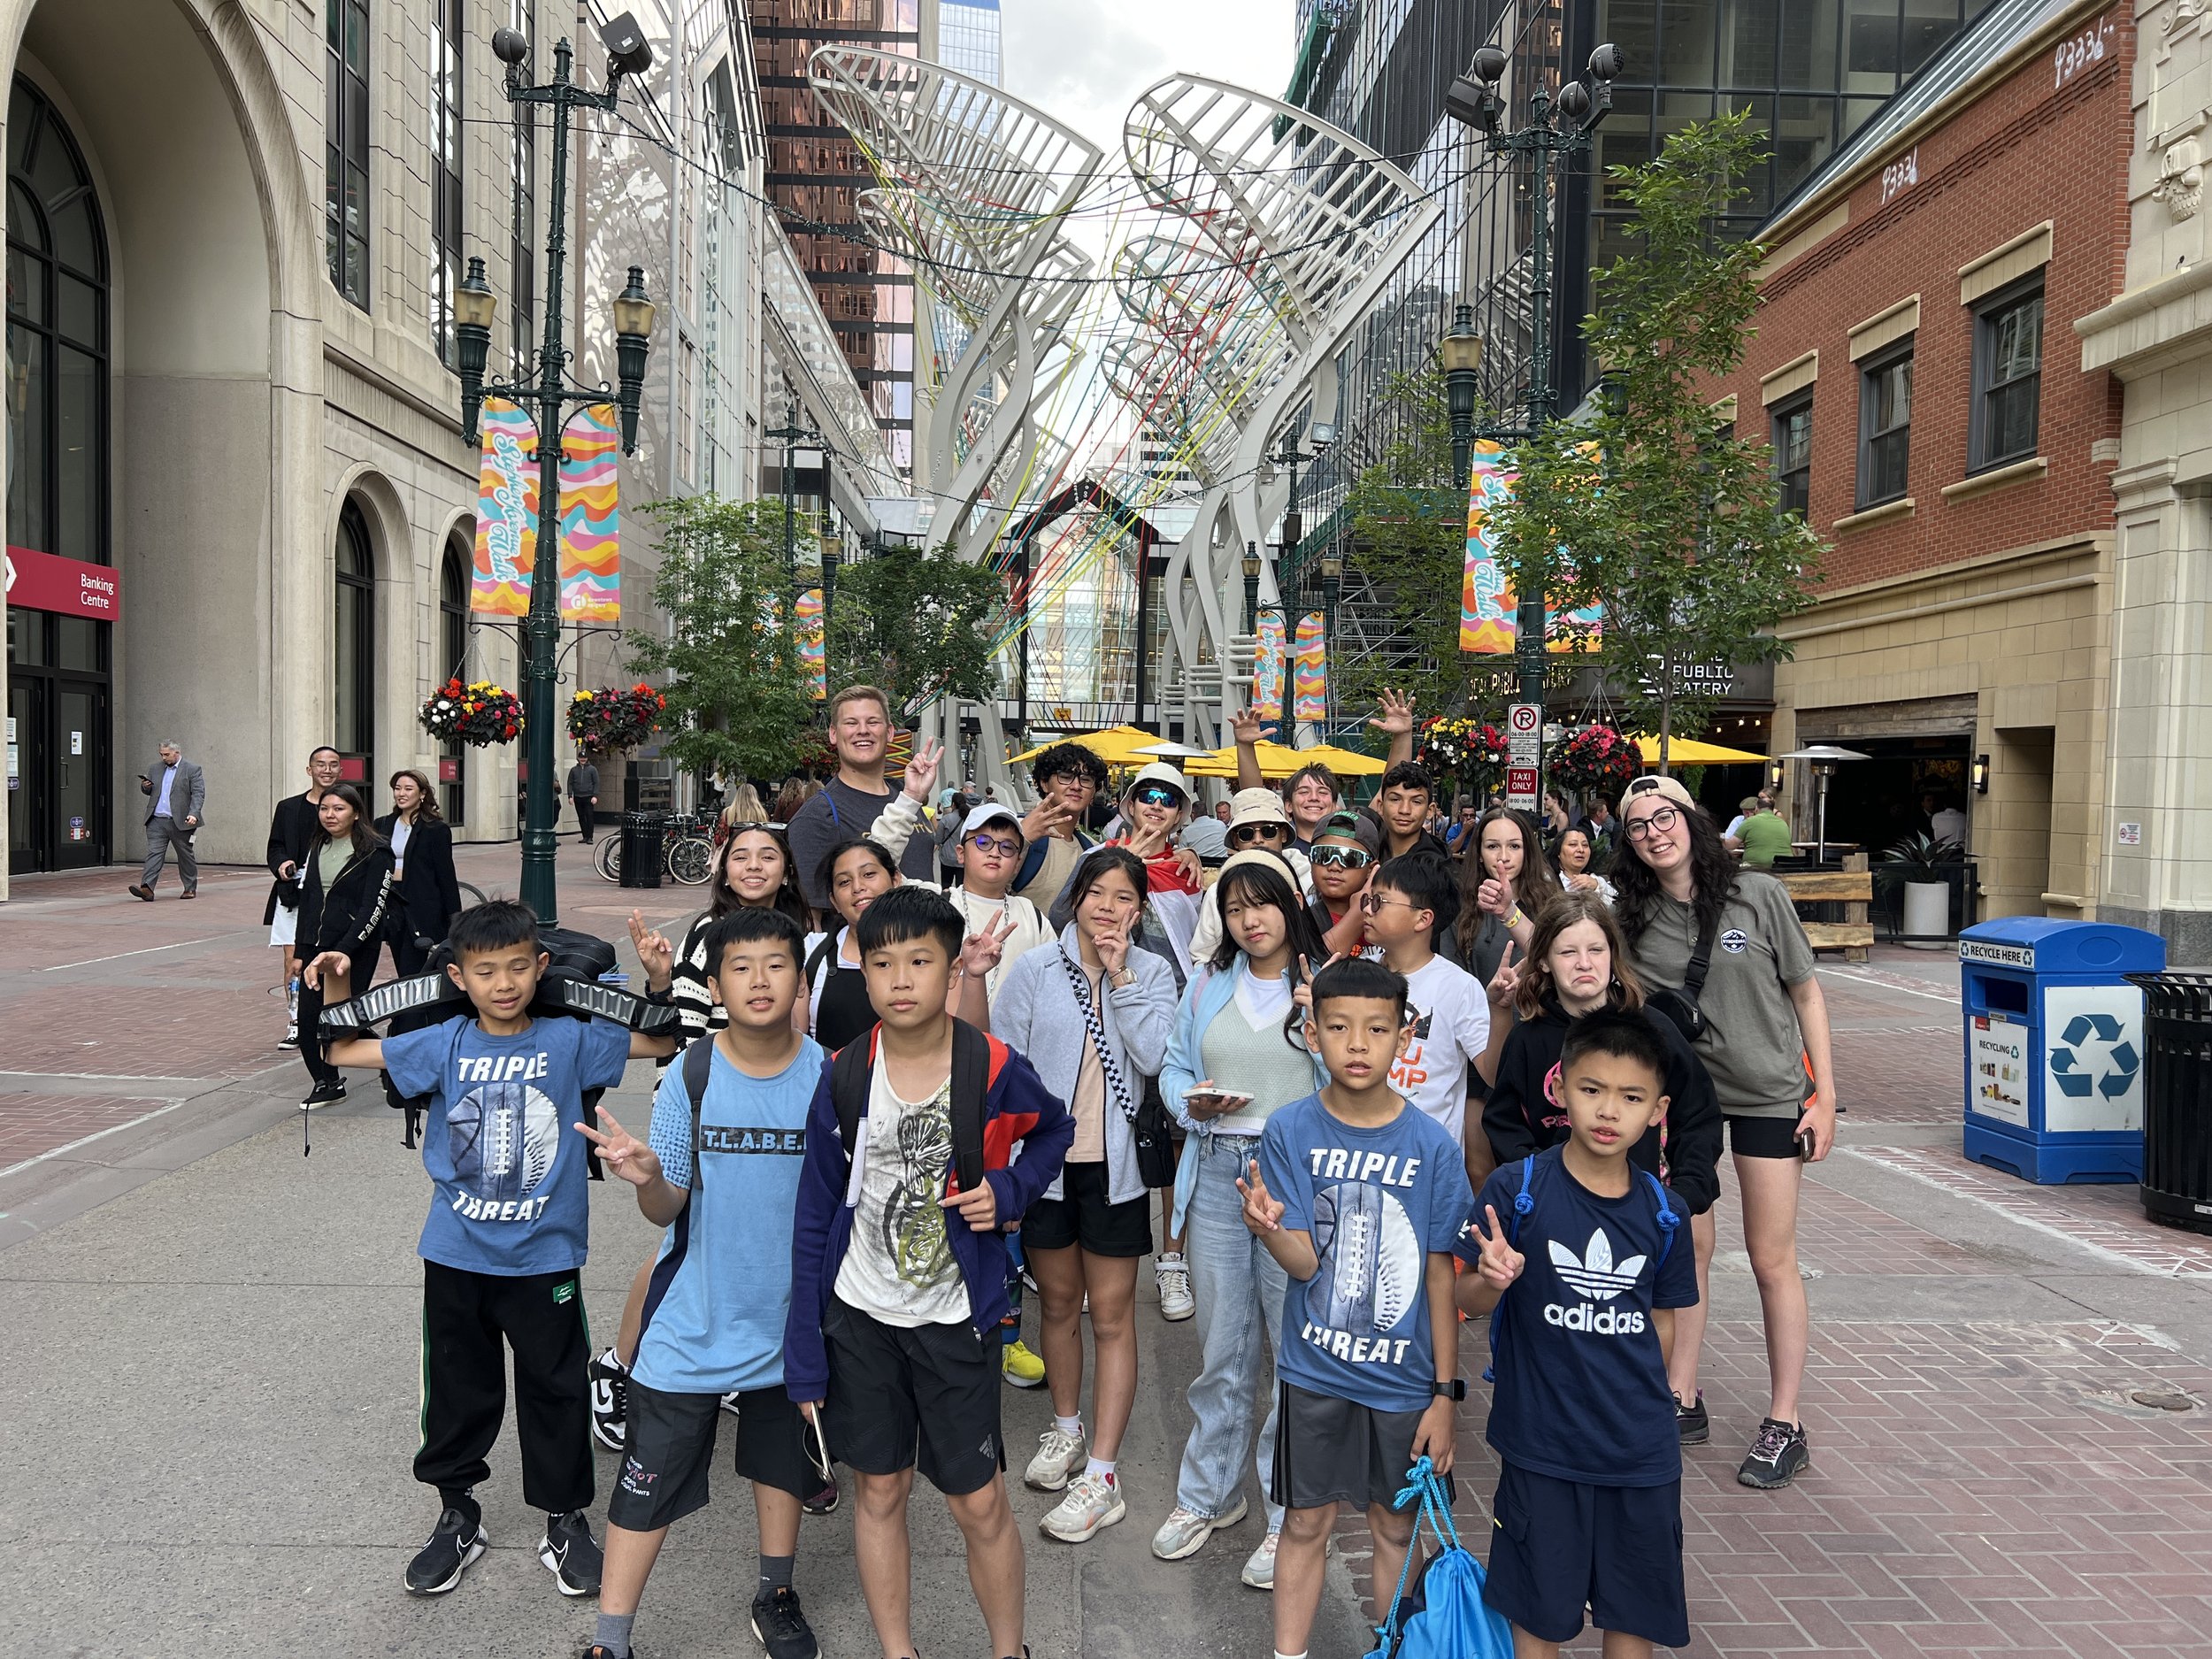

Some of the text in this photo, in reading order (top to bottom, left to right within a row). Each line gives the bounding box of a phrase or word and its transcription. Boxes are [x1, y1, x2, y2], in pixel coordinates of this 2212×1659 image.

[490, 435, 530, 580] Stephen Avenue Walk
[81, 573, 114, 595] Banking
[1475, 563, 1502, 619] Walk
[81, 591, 110, 609] Centre
[1970, 945, 2021, 963] RECYCLE HERE
[1979, 1040, 2009, 1055] RECYCLING
[457, 1052, 549, 1082] TRIPLE
[1310, 1148, 1421, 1187] TRIPLE
[451, 1190, 550, 1221] THREAT
[1544, 1302, 1645, 1335] adidas
[632, 1487, 650, 1497] PANTS
